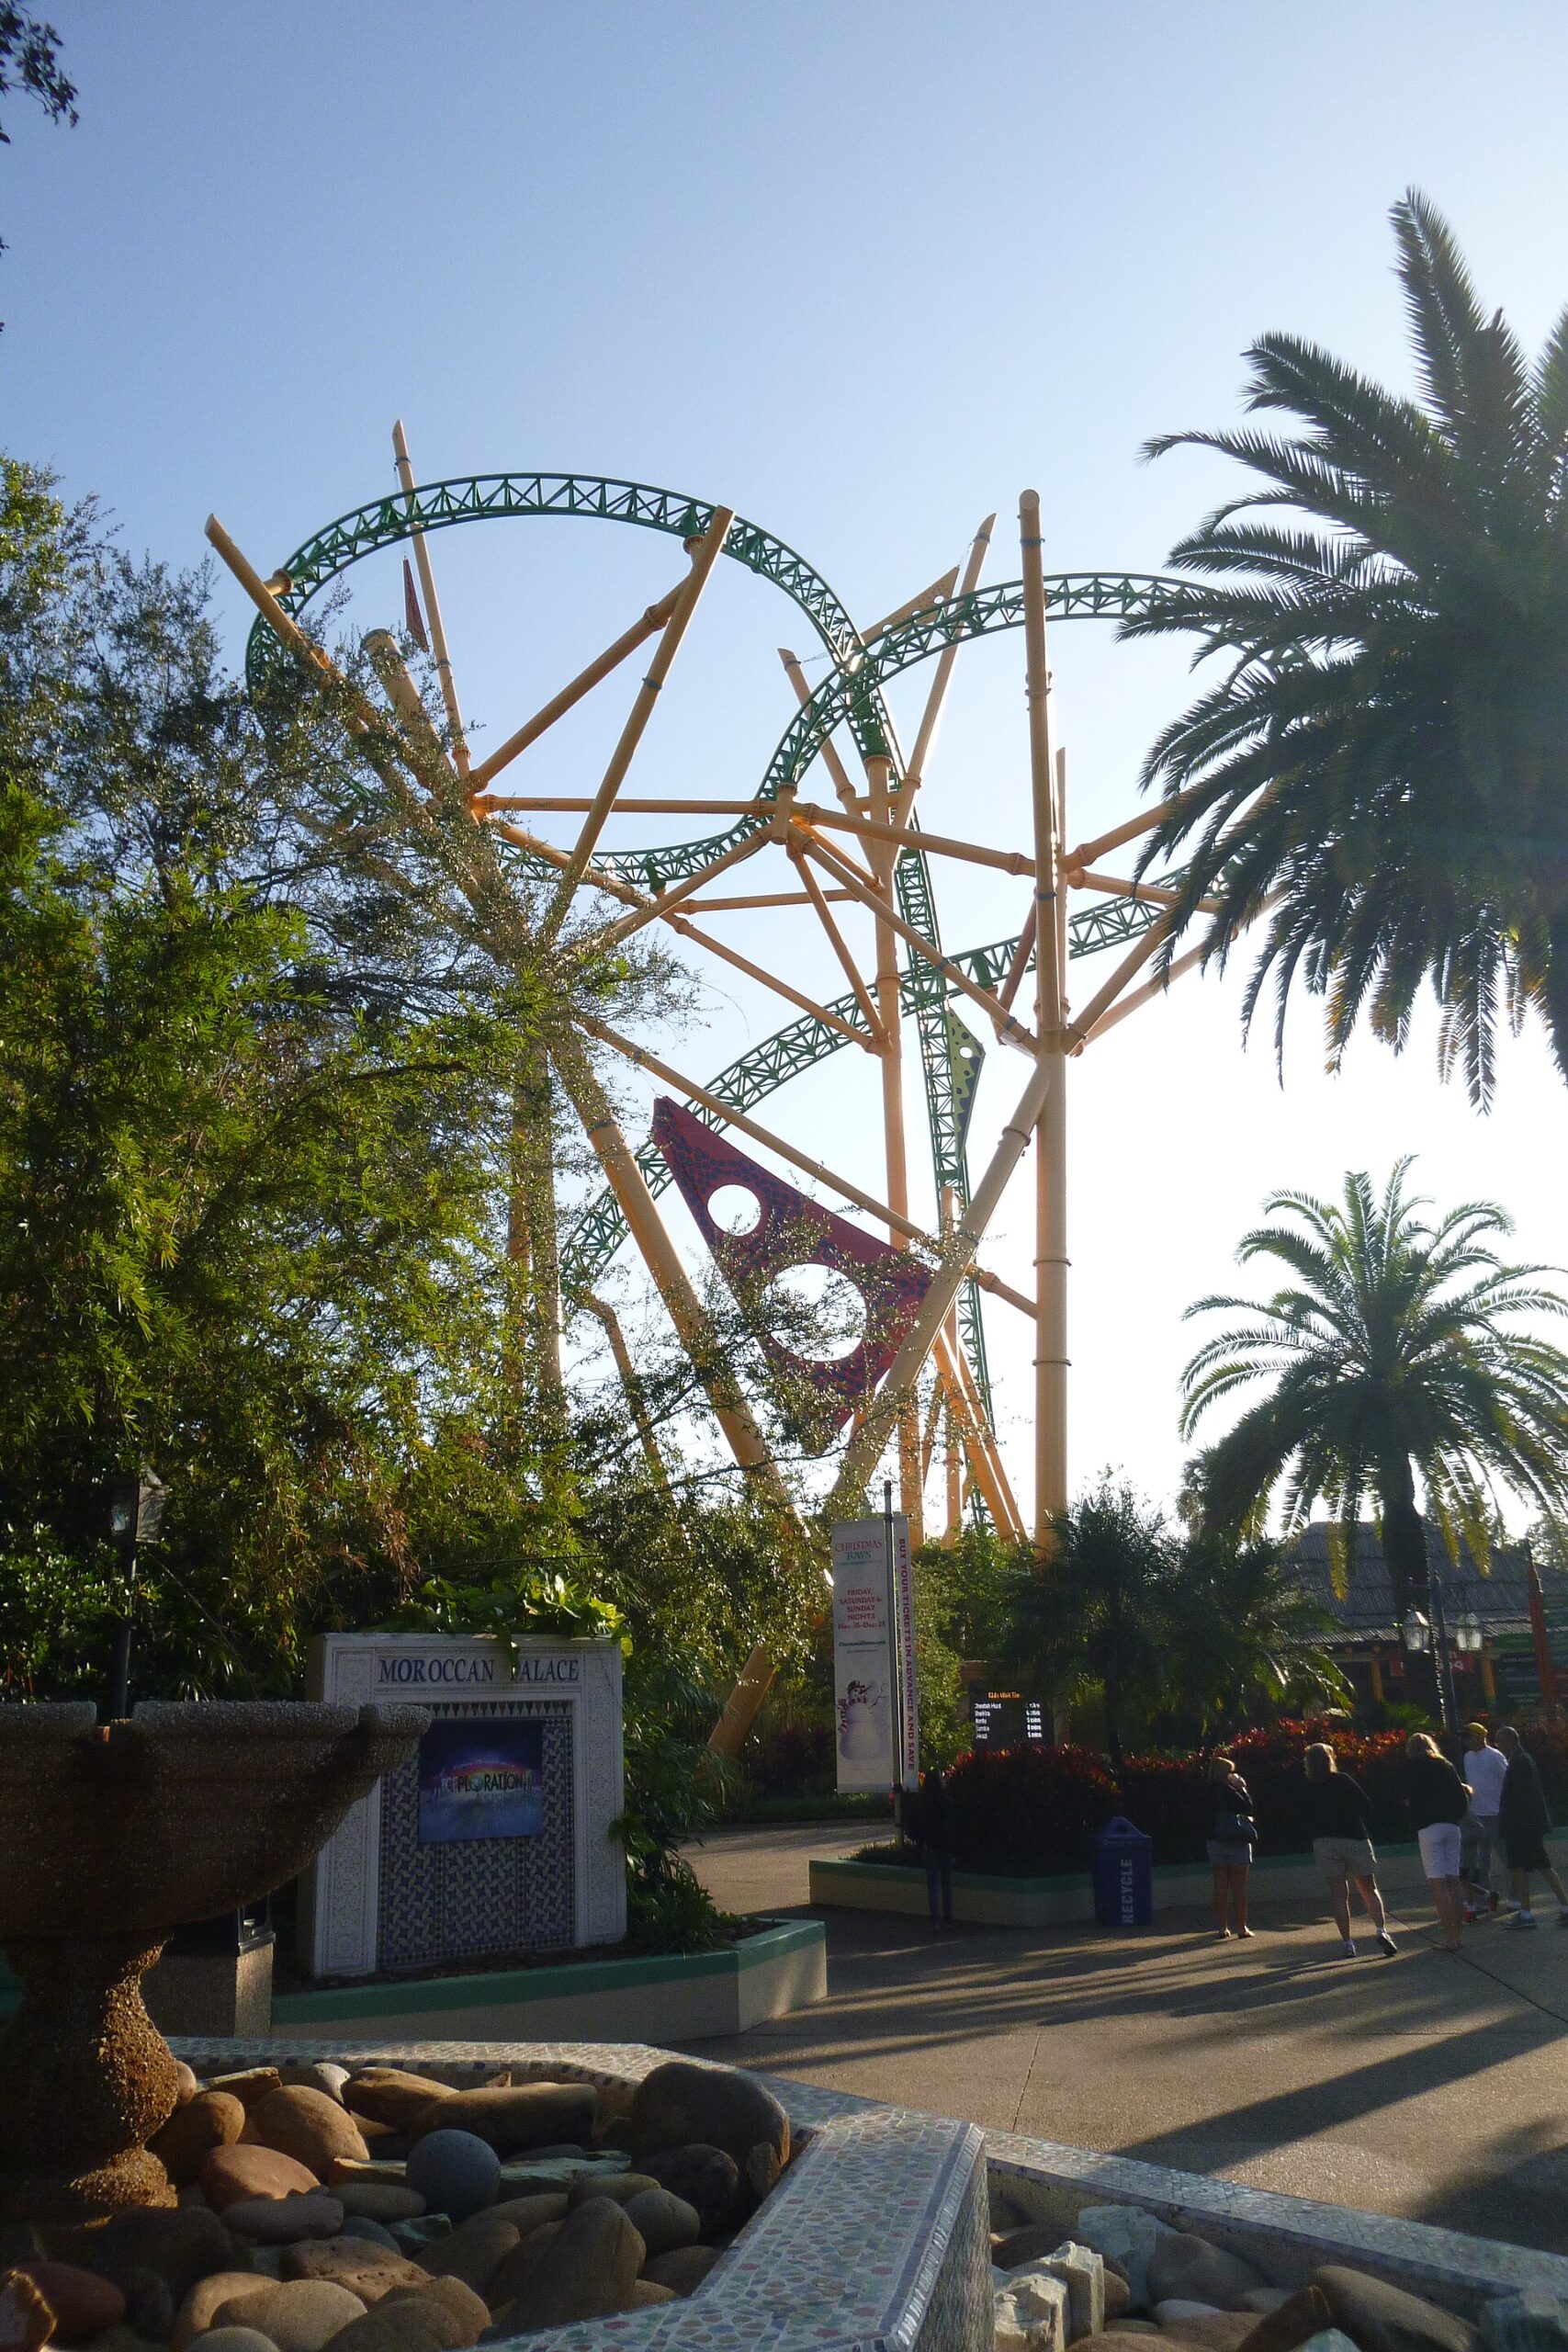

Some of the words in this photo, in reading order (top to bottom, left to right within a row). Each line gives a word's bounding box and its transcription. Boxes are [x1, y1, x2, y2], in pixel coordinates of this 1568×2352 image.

[834, 1539, 883, 1552] CHRISTMAS
[846, 1550, 872, 1560] TOWN
[846, 1604, 875, 1612] SUNDAY
[847, 1612, 875, 1621] NIGHTS
[906, 1643, 912, 1657] IN
[378, 1658, 494, 1682] MOROCCAN
[906, 1659, 914, 1712] ADVANCE
[908, 1741, 916, 1770] SAVE
[1120, 1859, 1134, 1924] RECYCLE
